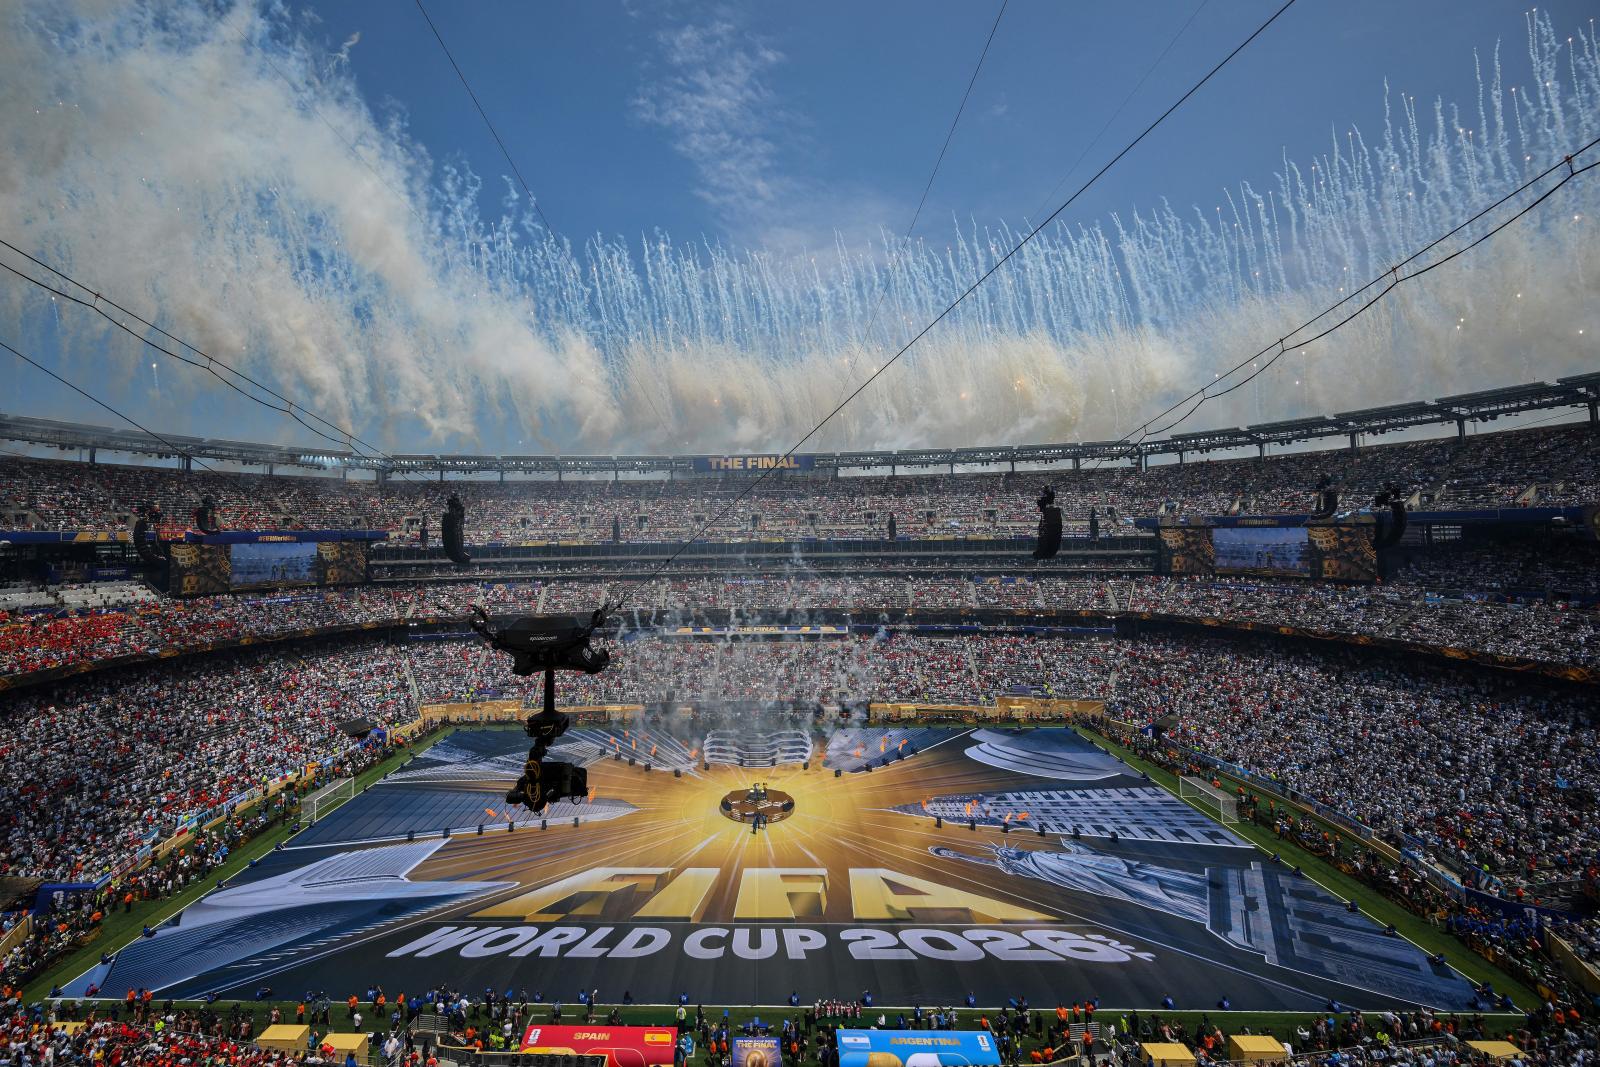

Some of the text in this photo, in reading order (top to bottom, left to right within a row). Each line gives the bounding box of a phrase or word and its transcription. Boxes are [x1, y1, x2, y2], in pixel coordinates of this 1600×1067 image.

[709, 456, 800, 469] THE FINAL
[466, 867, 1063, 922] FIFA
[385, 927, 671, 958] WORLD
[683, 928, 827, 960] CUP
[573, 1032, 611, 1040] SPAIN
[890, 1037, 961, 1046] ARGENTINA
